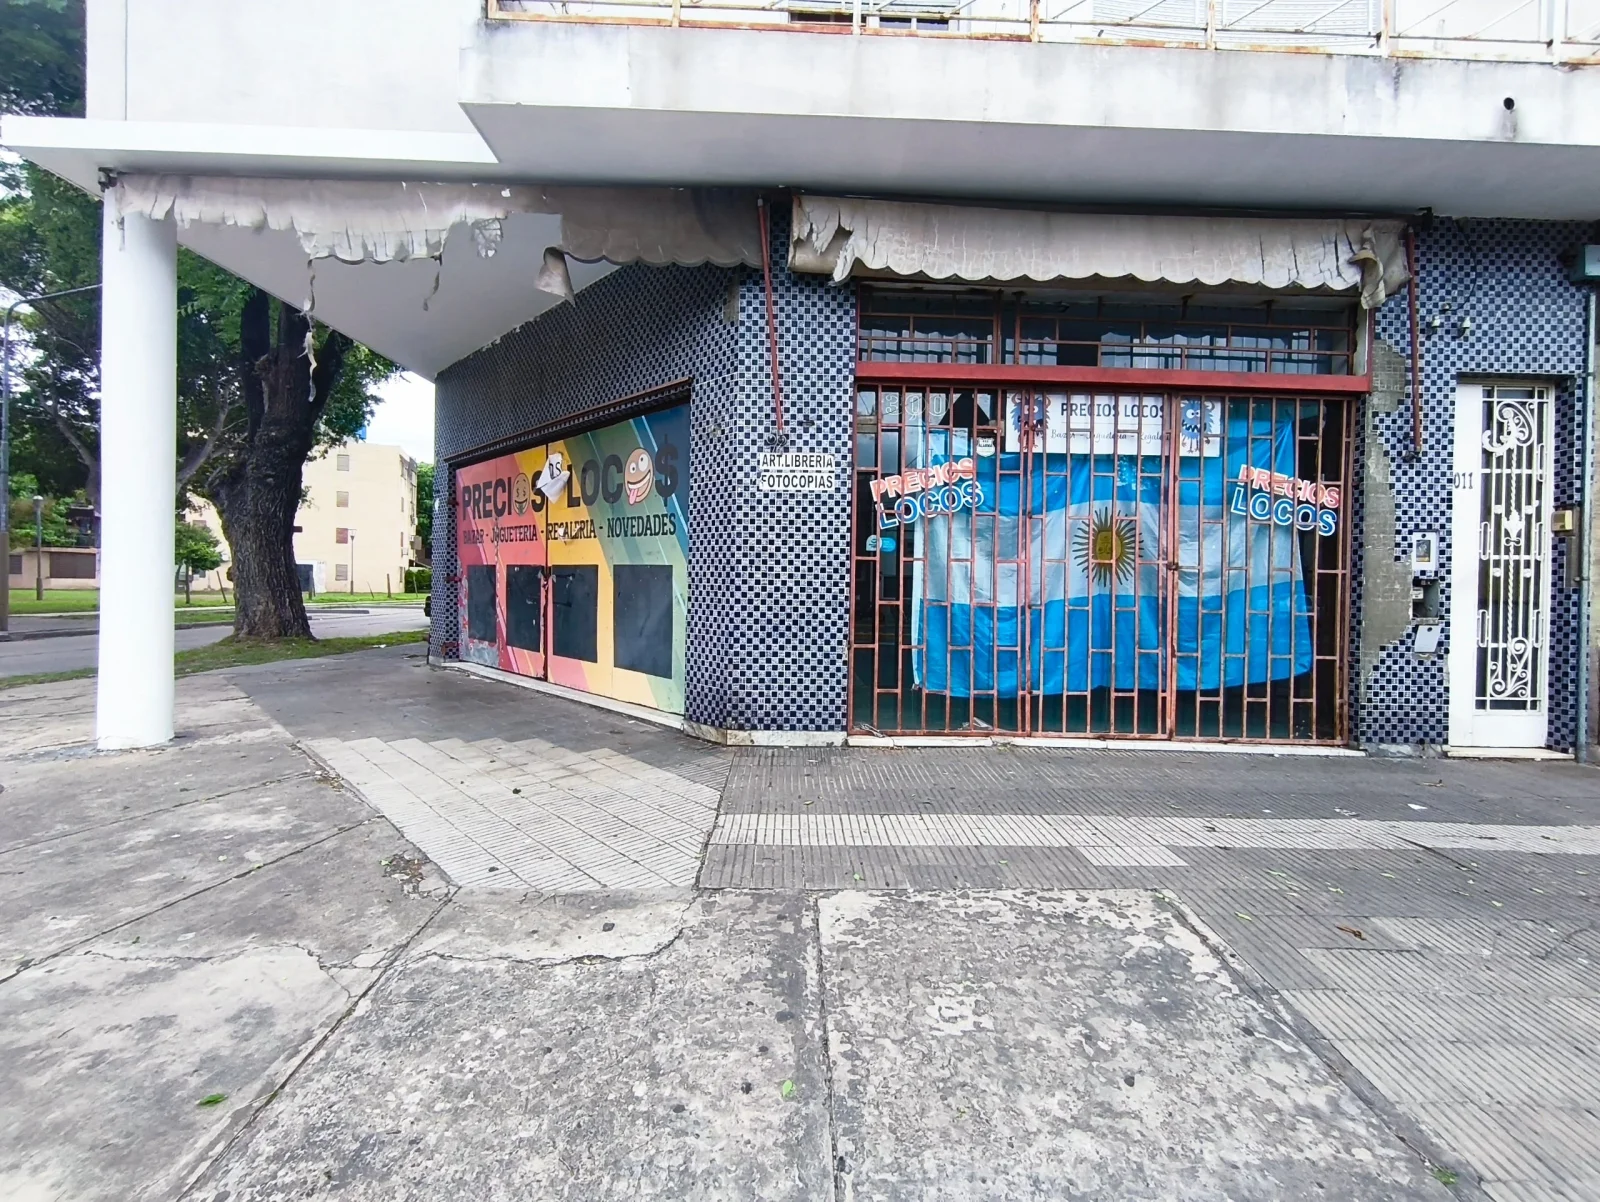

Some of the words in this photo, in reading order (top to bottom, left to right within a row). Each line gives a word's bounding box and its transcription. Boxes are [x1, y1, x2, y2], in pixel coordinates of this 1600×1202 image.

[761, 454, 833, 468] ART.LIBRERIA
[761, 474, 833, 489] FOTOCOPIAS
[870, 457, 974, 502] PRECIOS
[875, 480, 984, 530] LOCOS
[1237, 463, 1340, 508] PRECIOS
[607, 512, 677, 538] NOVEDADES
[1231, 486, 1337, 537] LOCOS
